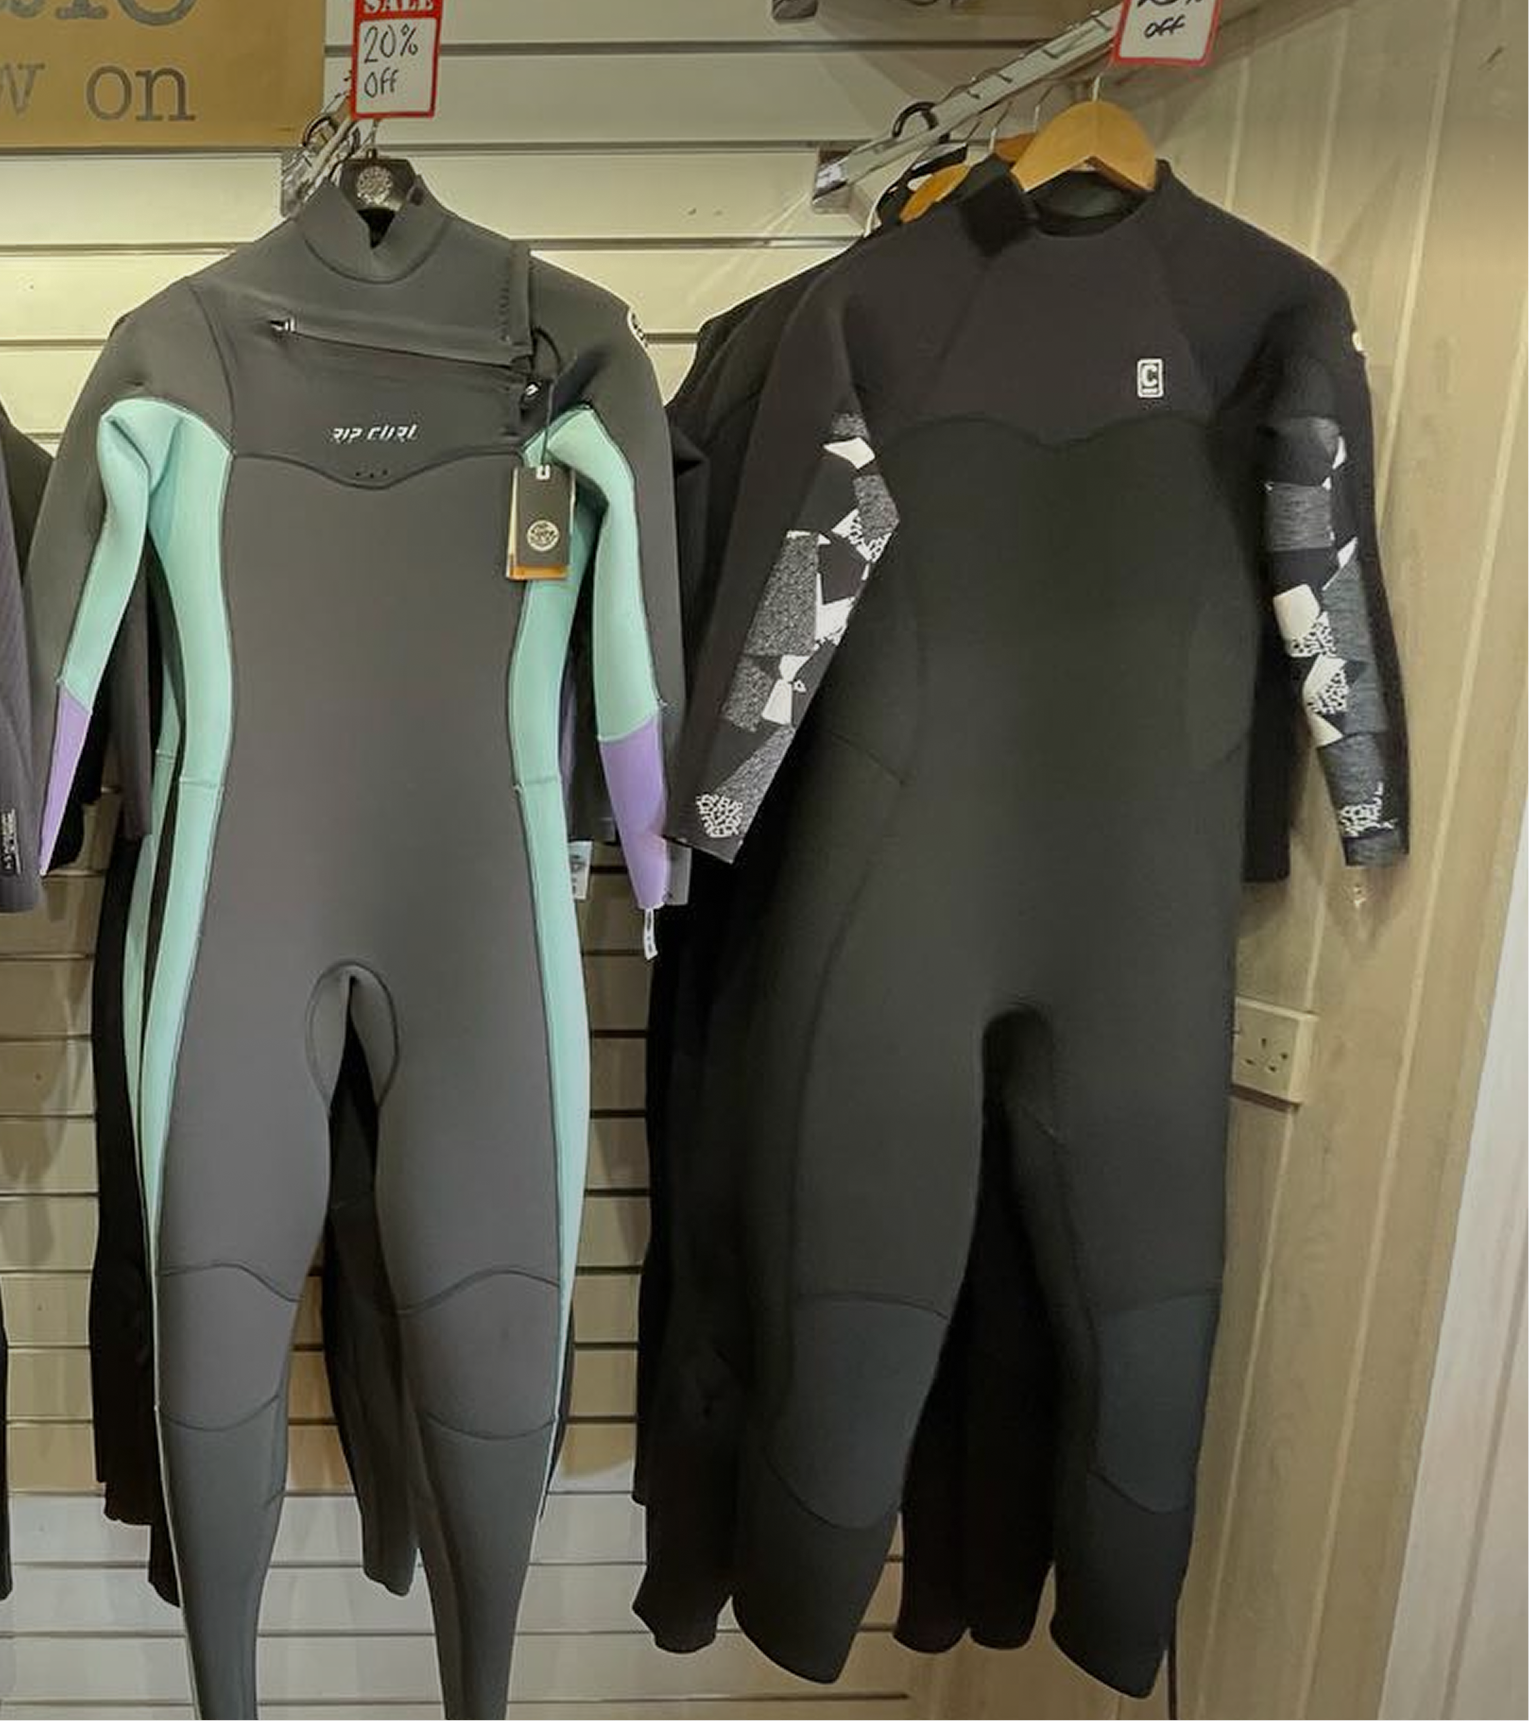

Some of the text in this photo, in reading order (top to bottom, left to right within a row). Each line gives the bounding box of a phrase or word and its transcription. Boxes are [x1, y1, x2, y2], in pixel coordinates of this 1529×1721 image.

[364, 24, 418, 64] 20%
[85, 65, 196, 121] on
[332, 423, 418, 444] RIP CURL
